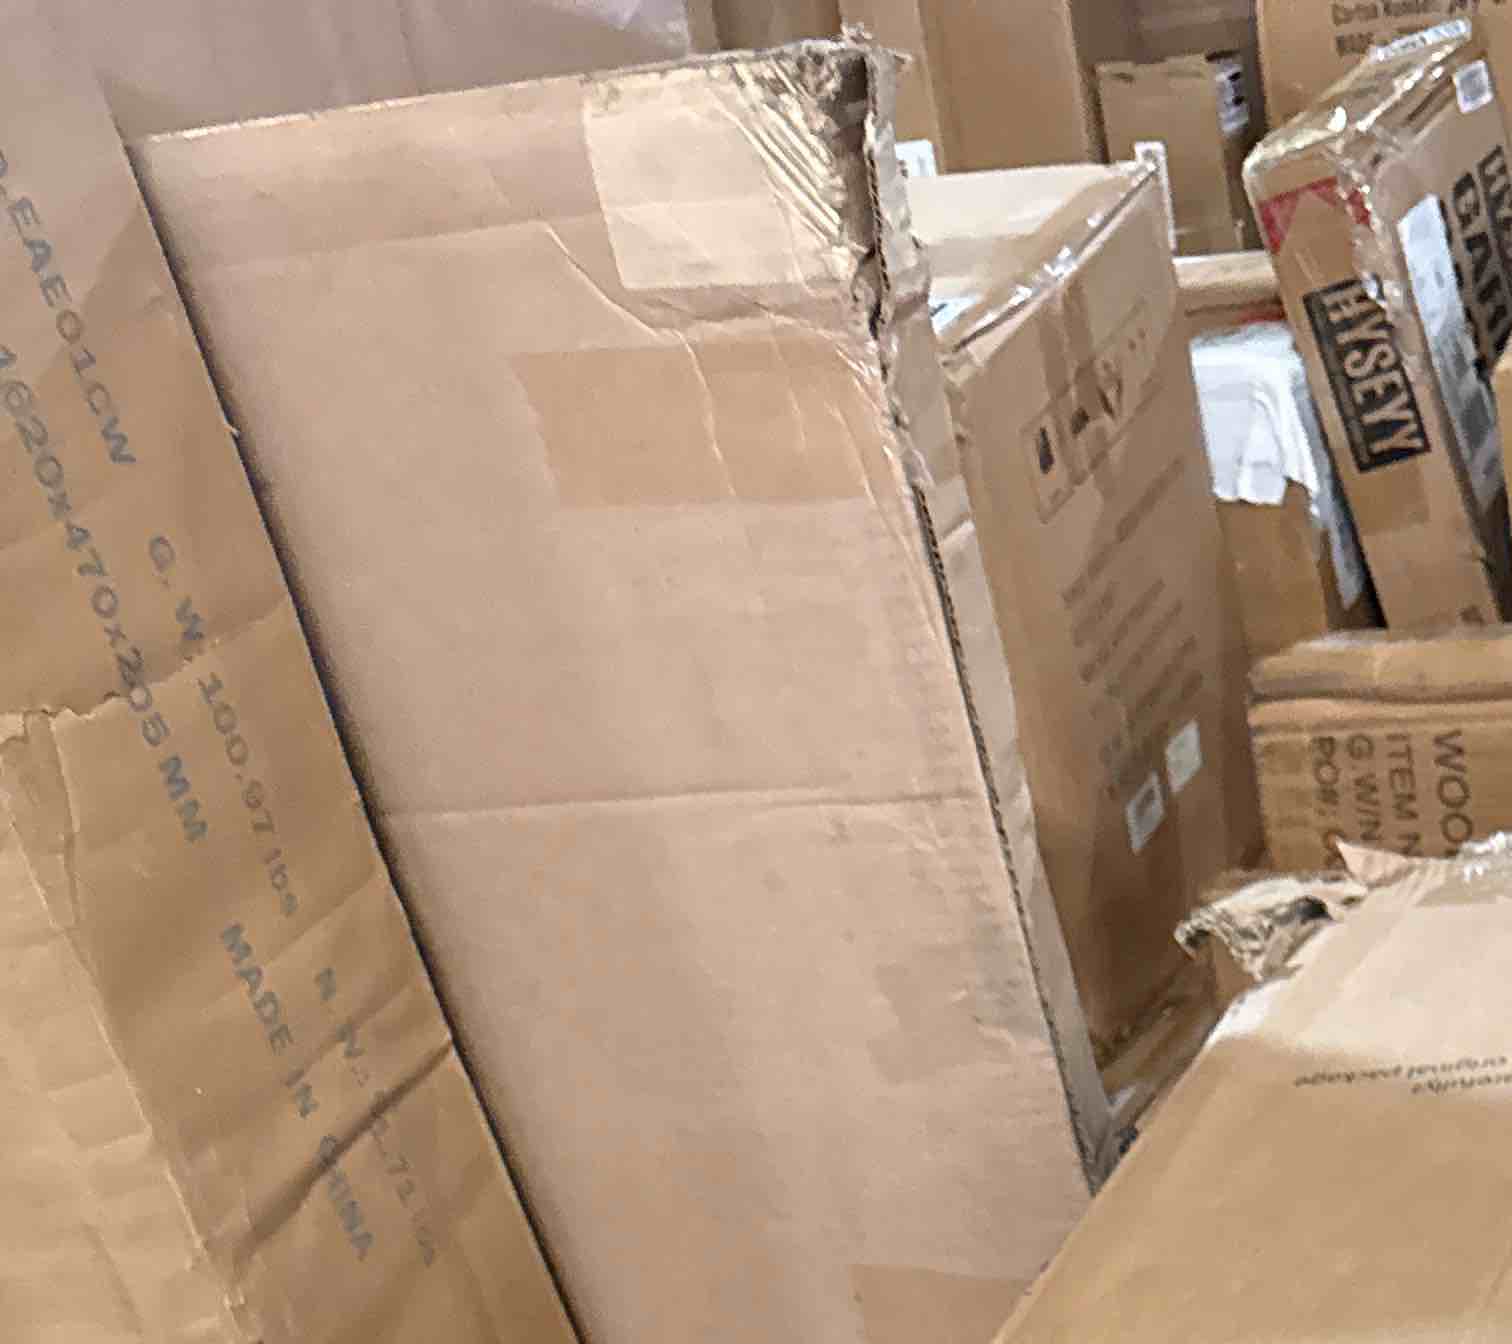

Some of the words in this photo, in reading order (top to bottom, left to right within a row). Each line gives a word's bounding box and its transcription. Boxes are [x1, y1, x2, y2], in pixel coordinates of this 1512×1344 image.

[1326, 280, 1427, 456] HYSEYY
[1386, 733, 1420, 821] ITEM
[1433, 730, 1473, 858] WOO
[161, 755, 210, 843] MM
[219, 922, 294, 1058] MADE
[284, 1067, 318, 1121] IN
[318, 1132, 375, 1263] CHINA
